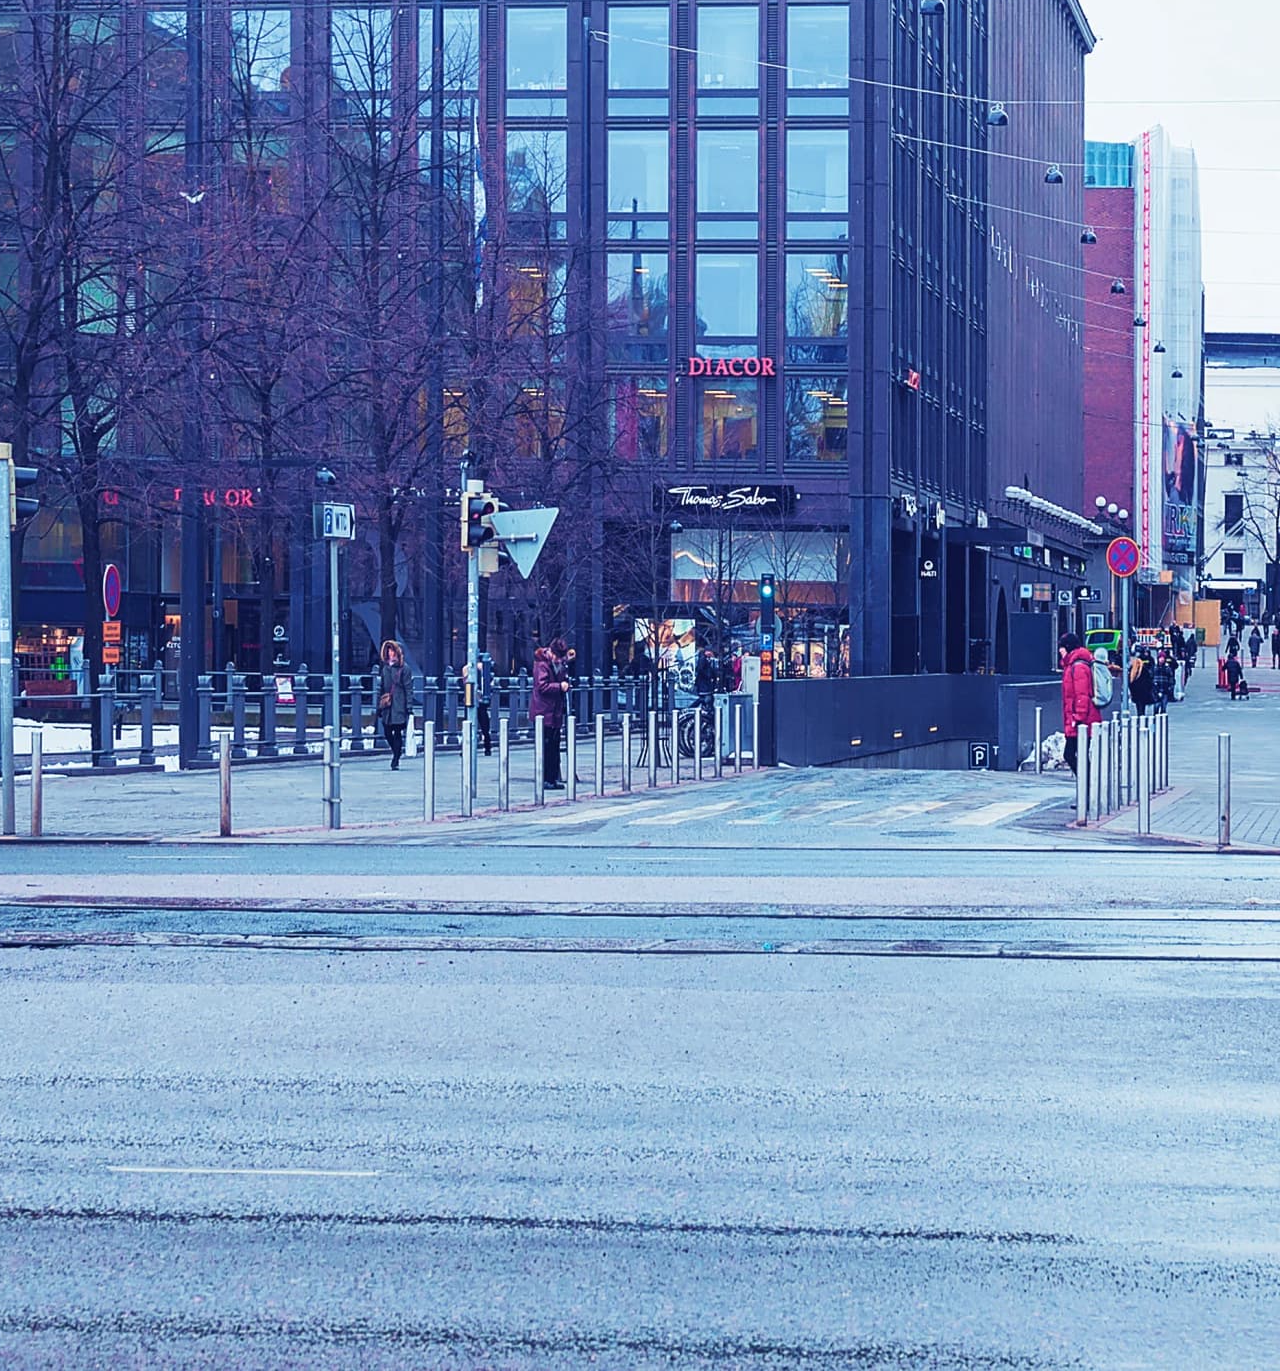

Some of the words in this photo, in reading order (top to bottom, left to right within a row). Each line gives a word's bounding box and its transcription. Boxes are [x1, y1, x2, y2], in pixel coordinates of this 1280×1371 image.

[688, 357, 775, 376] DIACOR
[668, 486, 723, 508] Thomas
[721, 486, 776, 510] Sabo
[763, 634, 771, 645] P
[975, 750, 984, 765] P
